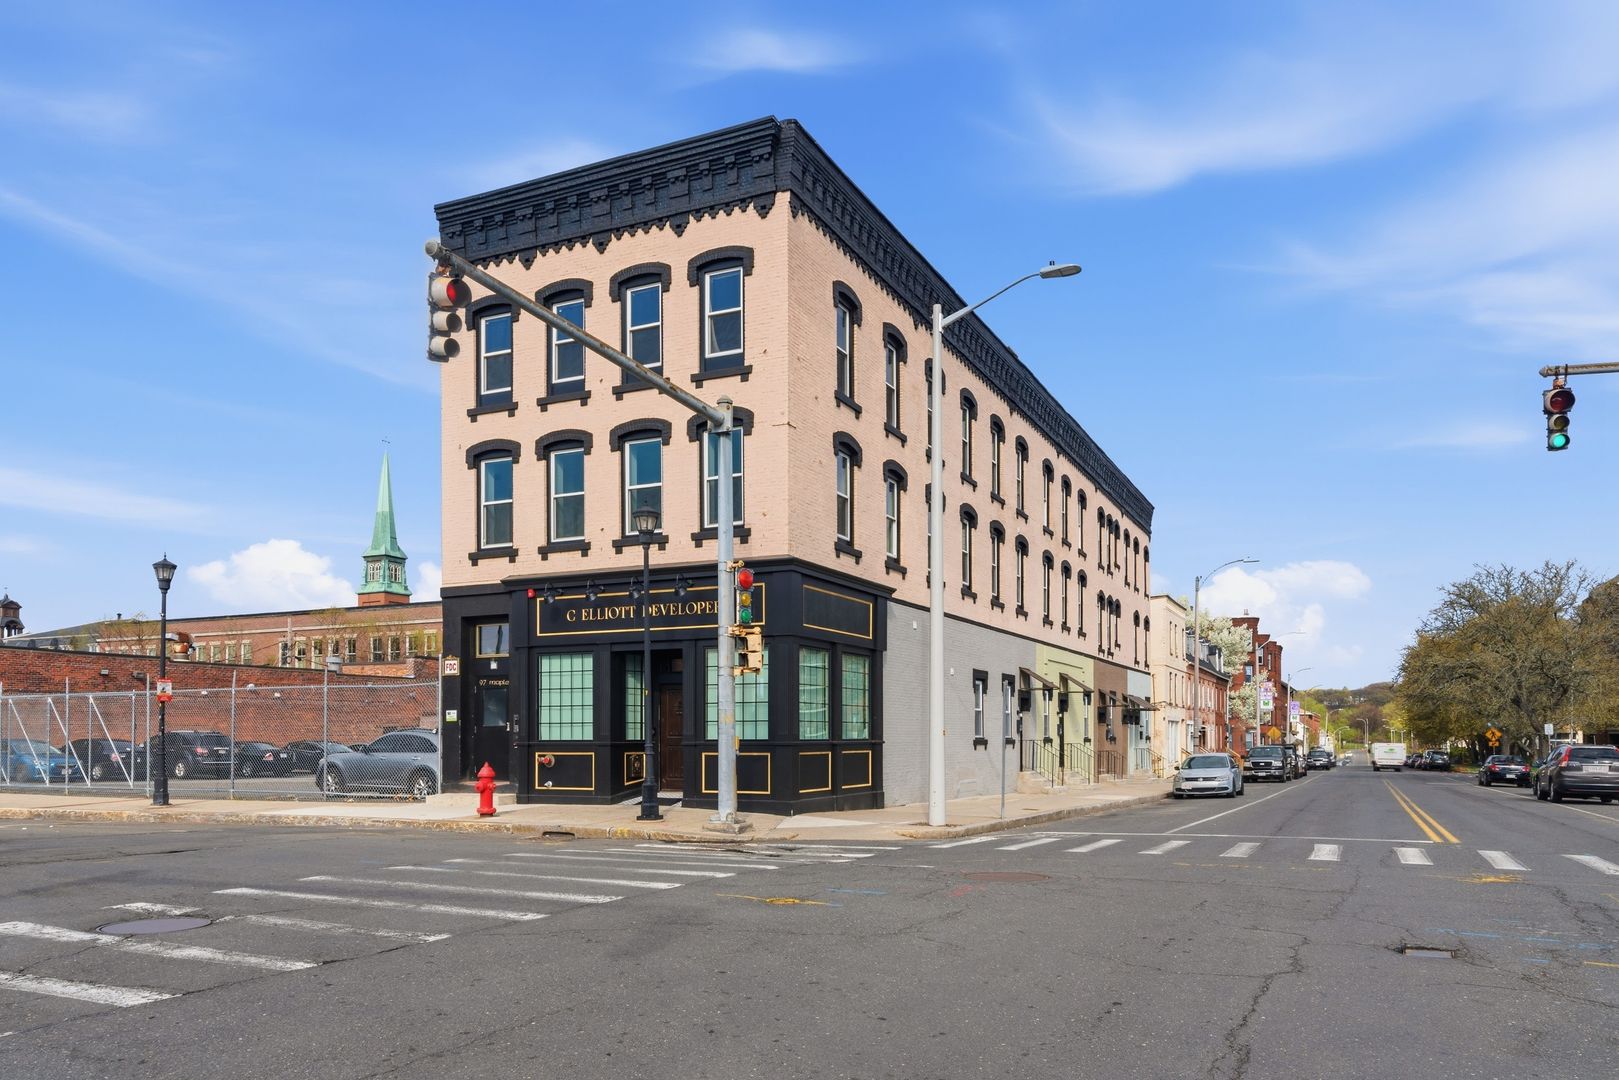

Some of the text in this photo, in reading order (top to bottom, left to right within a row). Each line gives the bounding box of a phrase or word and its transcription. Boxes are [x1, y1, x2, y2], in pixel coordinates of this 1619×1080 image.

[566, 609, 576, 622] C
[581, 605, 637, 621] ELLIOTT
[445, 662, 457, 671] FDC
